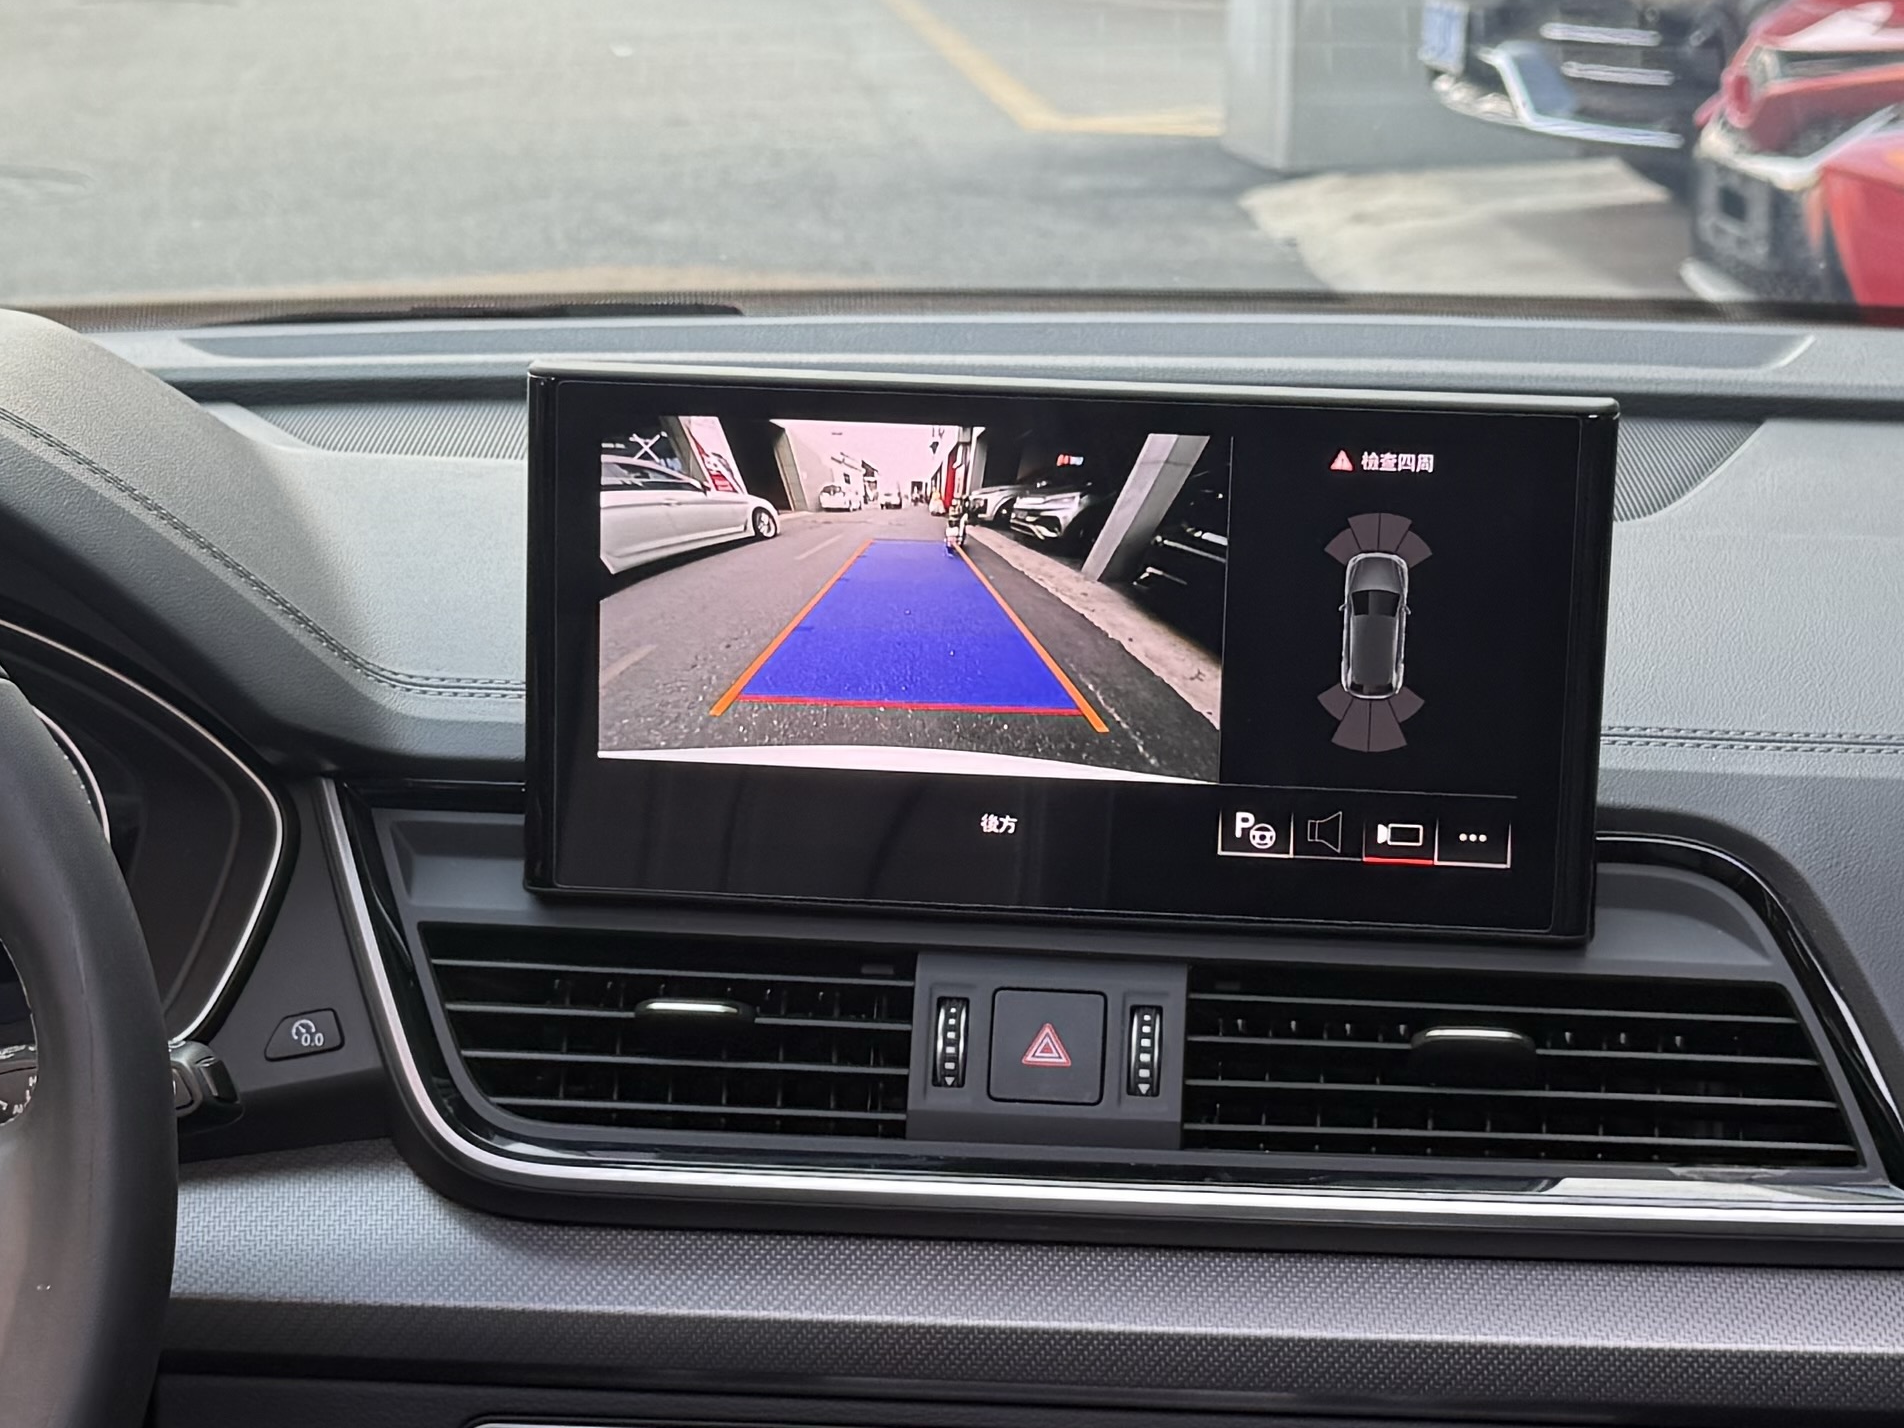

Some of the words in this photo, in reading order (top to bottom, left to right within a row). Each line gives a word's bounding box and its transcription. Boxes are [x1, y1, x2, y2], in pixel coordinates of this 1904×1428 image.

[1360, 451, 1435, 473] 檢查四周
[980, 813, 1018, 834] 後方
[300, 1032, 325, 1048] 0.0
